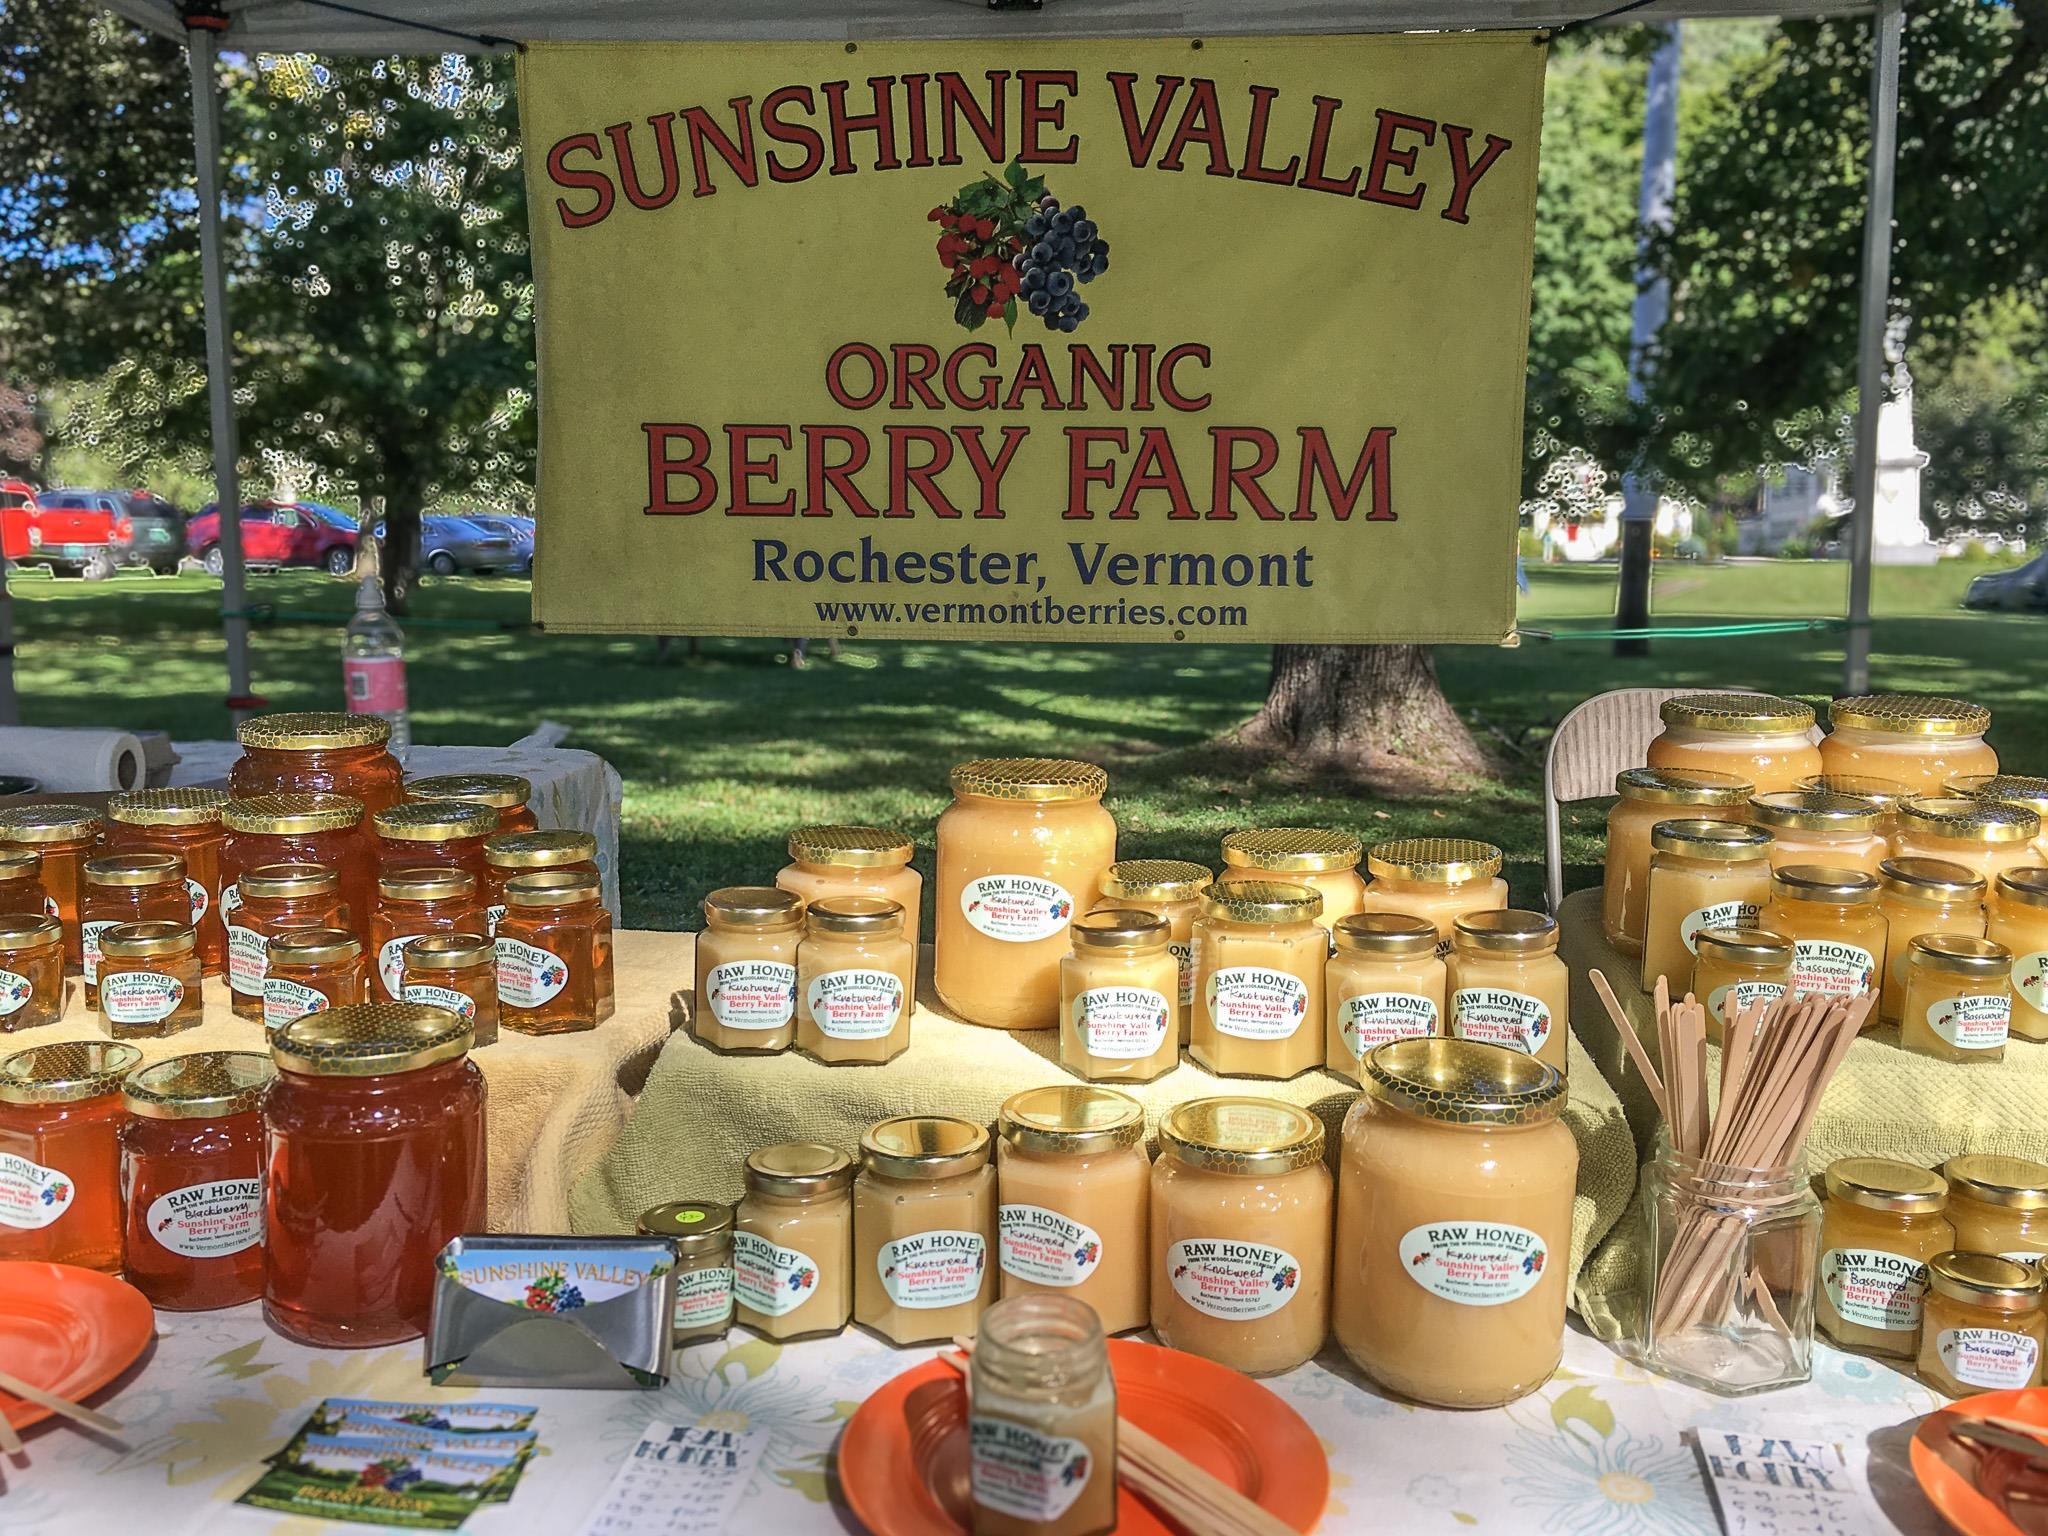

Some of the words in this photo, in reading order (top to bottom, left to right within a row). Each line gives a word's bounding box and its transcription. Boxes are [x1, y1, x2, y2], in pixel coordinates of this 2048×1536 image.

[546, 70, 1079, 229] SUNSHINE
[1107, 71, 1512, 224] VALLEY
[825, 341, 1212, 411] ORGANIC
[642, 422, 1030, 518] BERRY
[1062, 426, 1399, 522] FARM
[751, 537, 1047, 592] Rochester,
[1068, 541, 1313, 589] Vermont
[814, 598, 1248, 627] www.vermontberries.com
[978, 880, 1006, 892] RAW
[1011, 880, 1058, 896] HONEY
[984, 905, 1020, 914] Sunshine
[992, 912, 1014, 920] Berry
[1701, 906, 1732, 922] RAW
[510, 943, 550, 963] HONEY
[1819, 946, 1868, 964] HONEY
[717, 966, 745, 980] RAW
[751, 965, 795, 980] HONEY
[1796, 962, 1851, 976] Basswood
[132, 974, 173, 985] HONEY
[820, 975, 849, 990] RAW
[1215, 973, 1245, 987] RAW
[1252, 973, 1299, 992] HONEY
[1794, 980, 1821, 990] Berry
[1824, 982, 1851, 991] Farm
[1833, 975, 1861, 985] Valley
[280, 982, 314, 997] HONEY
[426, 988, 463, 1001] HONEY
[1758, 985, 1785, 995] HON
[729, 1001, 756, 1009] Berry
[1082, 993, 1109, 1008] RAW
[1220, 1000, 1260, 1010] Sunshine
[1265, 1004, 1291, 1013] Valley
[1351, 997, 1380, 1012] RAW
[1386, 997, 1432, 1012] HONEY
[1456, 994, 1481, 1006] RAW
[1488, 994, 1539, 1013] HONEY
[1953, 999, 1979, 1011] RAW
[832, 1010, 858, 1019] Berry
[1229, 1009, 1255, 1017] Berry
[1258, 1010, 1282, 1019] Farm
[1466, 1029, 1495, 1039] Berry
[1497, 1031, 1521, 1040] Farm
[1503, 1024, 1531, 1035] Valley
[5, 1157, 50, 1181] HONEY
[168, 1189, 204, 1208] RAW
[212, 1183, 259, 1198] HONE
[185, 1202, 248, 1219] Blackberry
[178, 1218, 226, 1228] Sunshine
[229, 1211, 259, 1222] Valley
[1000, 1211, 1026, 1223] RAW
[1032, 1212, 1086, 1240] HONEY
[189, 1227, 219, 1236] Berry
[223, 1221, 248, 1230] Farm
[1428, 1228, 1469, 1242] RAW
[1476, 1228, 1535, 1247] HONEY
[752, 1239, 799, 1265] HONEY
[892, 1238, 924, 1258] RAW
[1003, 1237, 1043, 1252] Sunshine
[1045, 1245, 1072, 1260] Valley
[1183, 1244, 1216, 1256] RAW
[1223, 1245, 1283, 1264] HONEY
[1012, 1247, 1038, 1260] Berry
[1040, 1253, 1063, 1265] Farm
[1835, 1254, 1867, 1266] RAW
[898, 1269, 942, 1279] Sunshine
[946, 1266, 974, 1275] Valley
[1203, 1263, 1264, 1279] Knotweed
[1435, 1258, 1486, 1271] Sunshine
[1491, 1263, 1520, 1272] Valley
[1861, 1267, 1896, 1277] WOODLANDS
[460, 1261, 569, 1287] SUNSHINE
[576, 1262, 649, 1287] VALLEY
[908, 1277, 938, 1286] Berry
[939, 1275, 965, 1283] Farm
[1190, 1271, 1236, 1286] Sunshine
[1239, 1279, 1270, 1290] Valley
[1447, 1268, 1478, 1280] Berry
[1482, 1272, 1509, 1280] Farm
[1850, 1271, 1907, 1292] Basswood
[1200, 1282, 1229, 1295] Berry
[1232, 1287, 1259, 1295] Farm
[1837, 1280, 1886, 1297] Sunshine
[1890, 1291, 1921, 1304] Valley
[1847, 1292, 1878, 1304] Berry
[1881, 1297, 1910, 1309] Farm
[1953, 1330, 1983, 1341] RAW
[1957, 1352, 2002, 1363] Sunshine
[1965, 1343, 2015, 1357] Basswood
[1967, 1359, 1994, 1370] Berry
[1996, 1363, 2018, 1372] Farm
